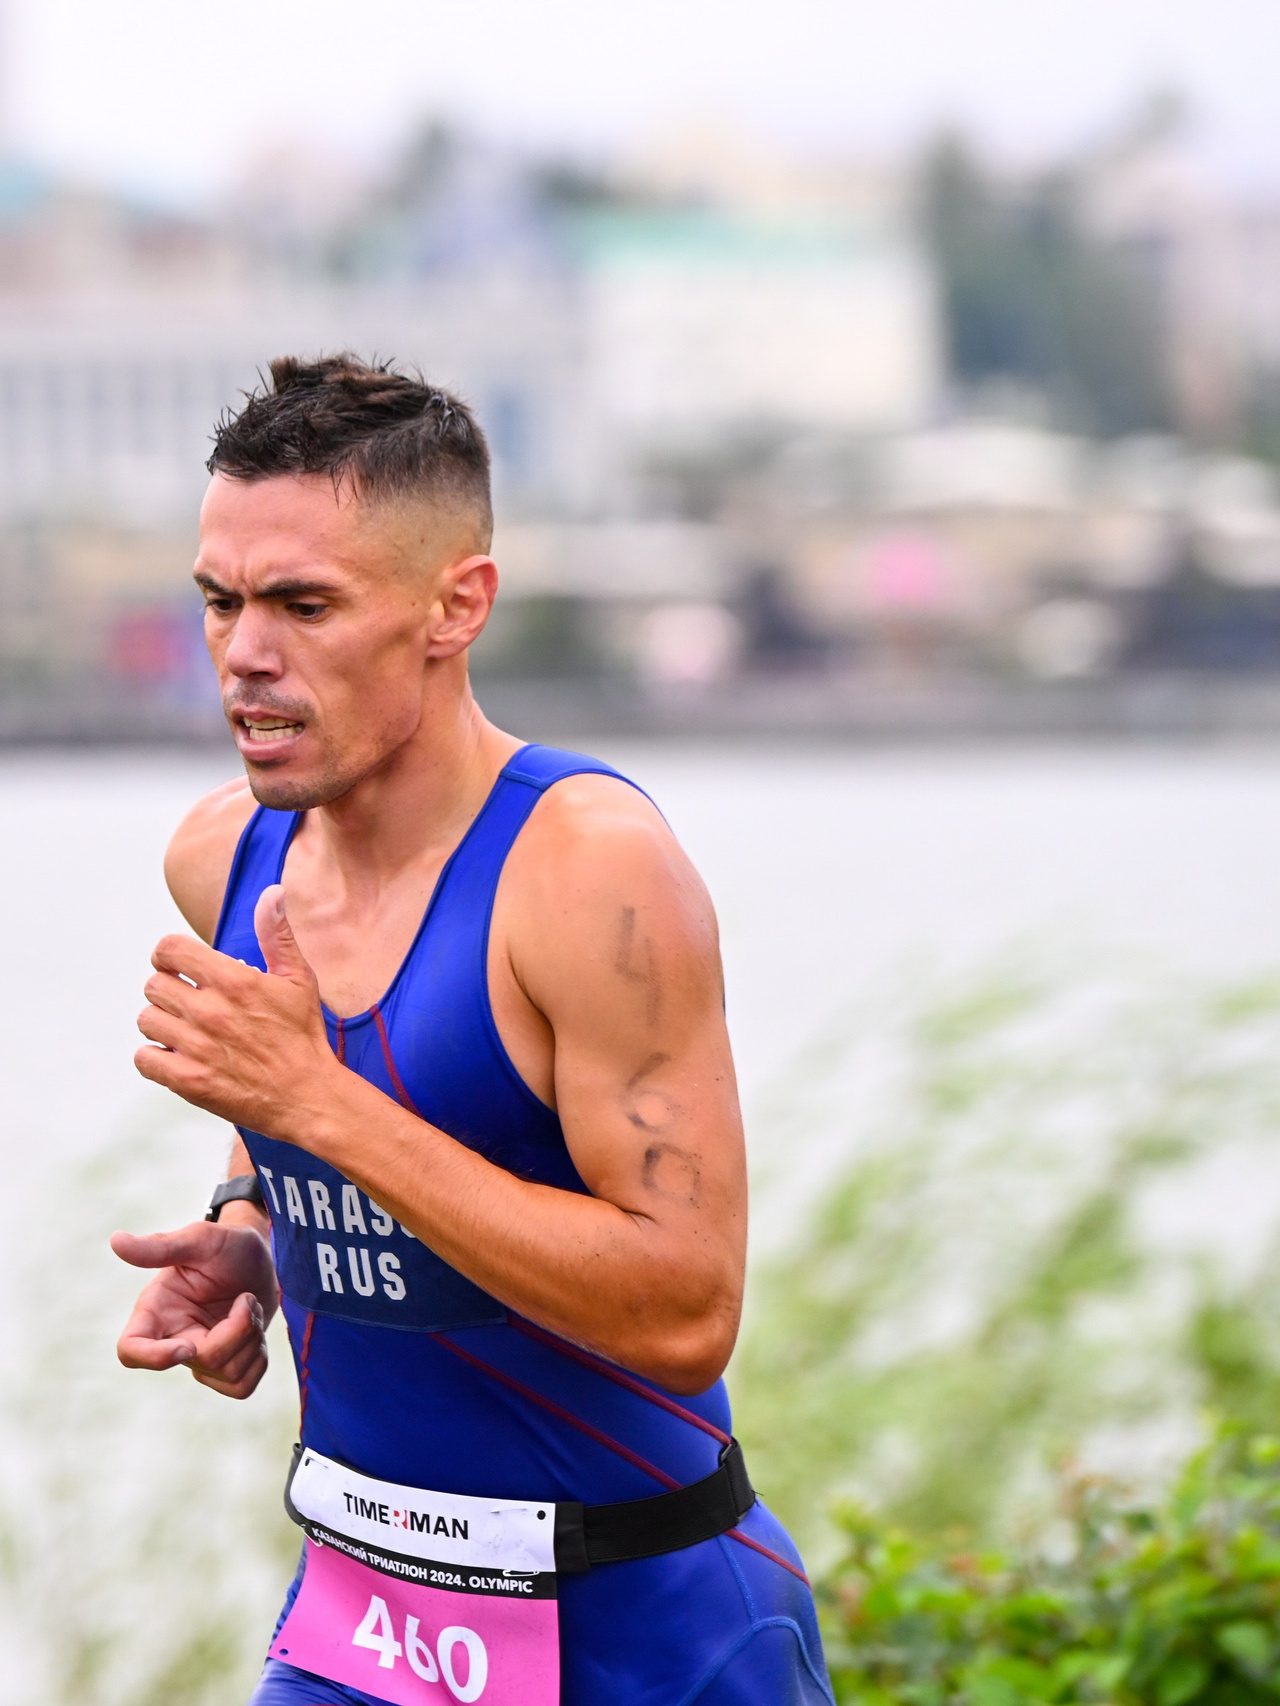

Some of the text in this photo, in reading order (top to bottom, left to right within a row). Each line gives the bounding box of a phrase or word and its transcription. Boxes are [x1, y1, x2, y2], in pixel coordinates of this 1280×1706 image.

[258, 1164, 418, 1238] TARAS
[316, 1242, 407, 1300] RUS
[311, 1526, 534, 1594] КАЗАНСКИЙ ТРИАТЛОН 2024. OLYMPIC
[351, 1594, 489, 1704] 460
